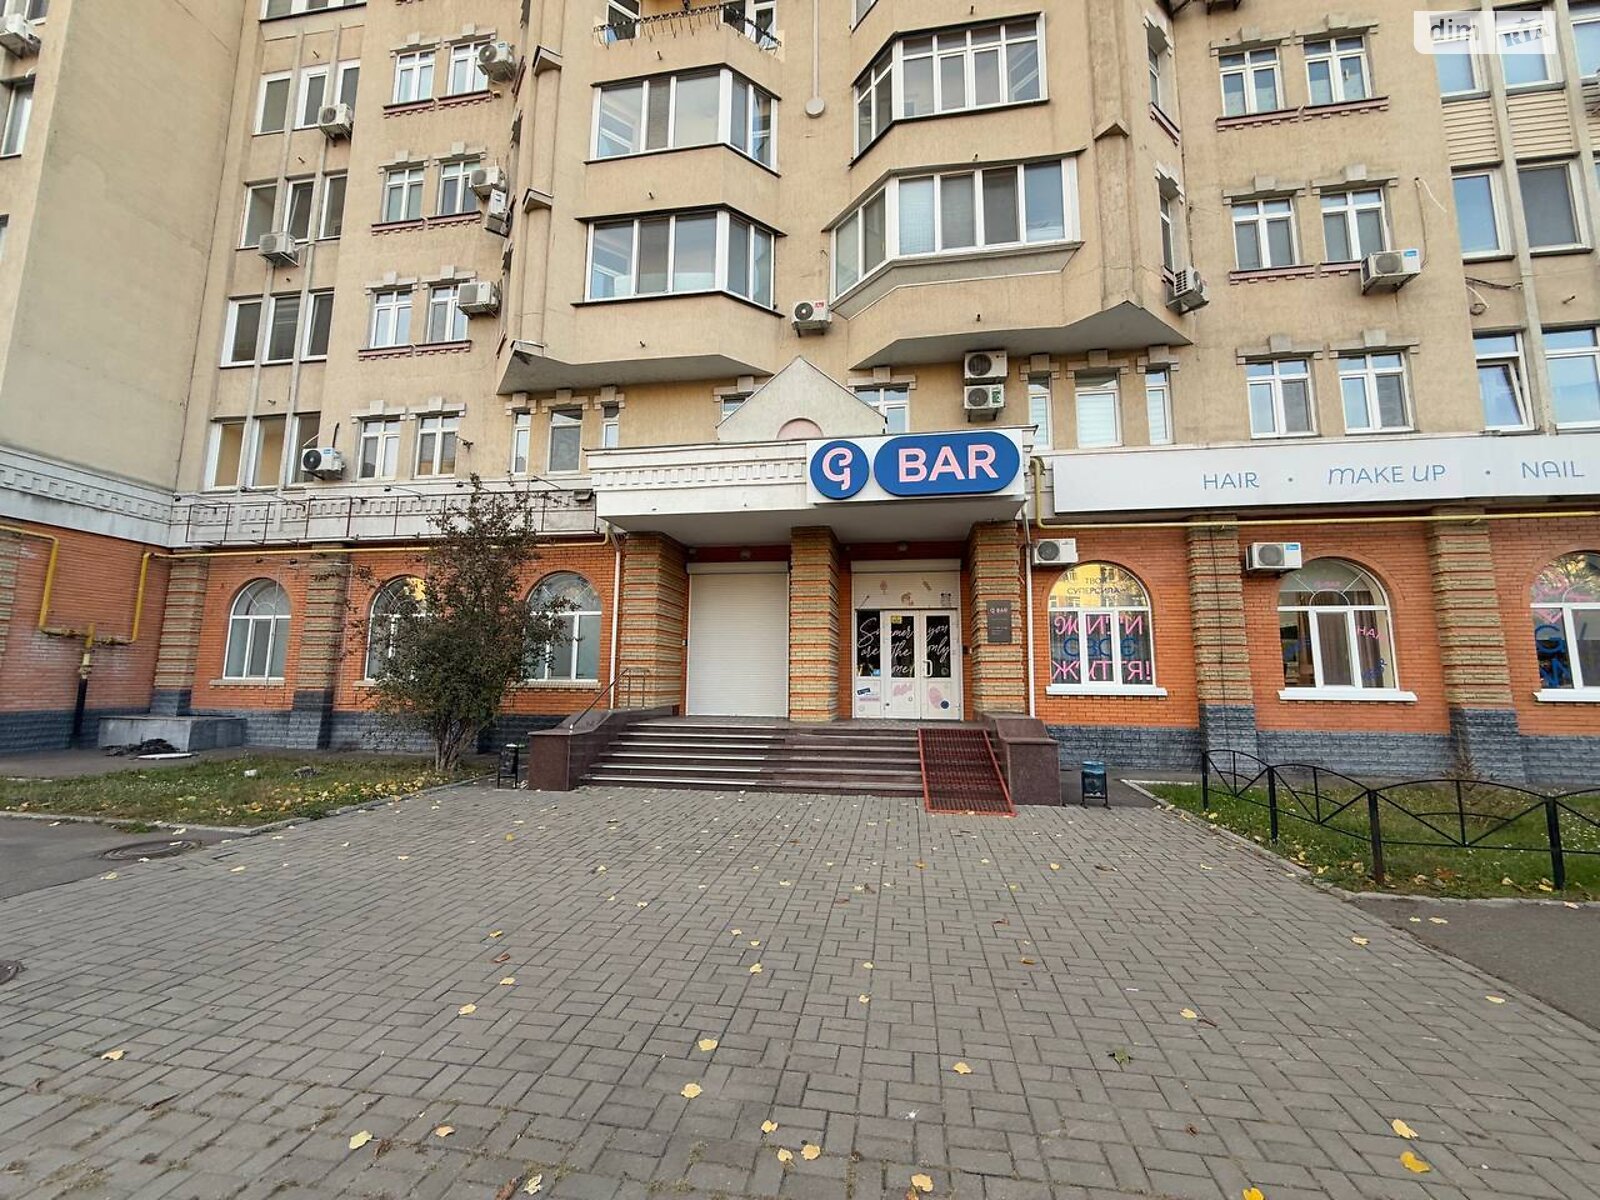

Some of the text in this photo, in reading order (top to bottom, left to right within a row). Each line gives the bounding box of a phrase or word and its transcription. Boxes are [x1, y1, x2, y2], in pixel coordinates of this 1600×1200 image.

[897, 443, 1000, 483] BAR
[1203, 471, 1260, 490] HAIR
[1412, 463, 1447, 483] UP
[1521, 460, 1586, 479] NAIL
